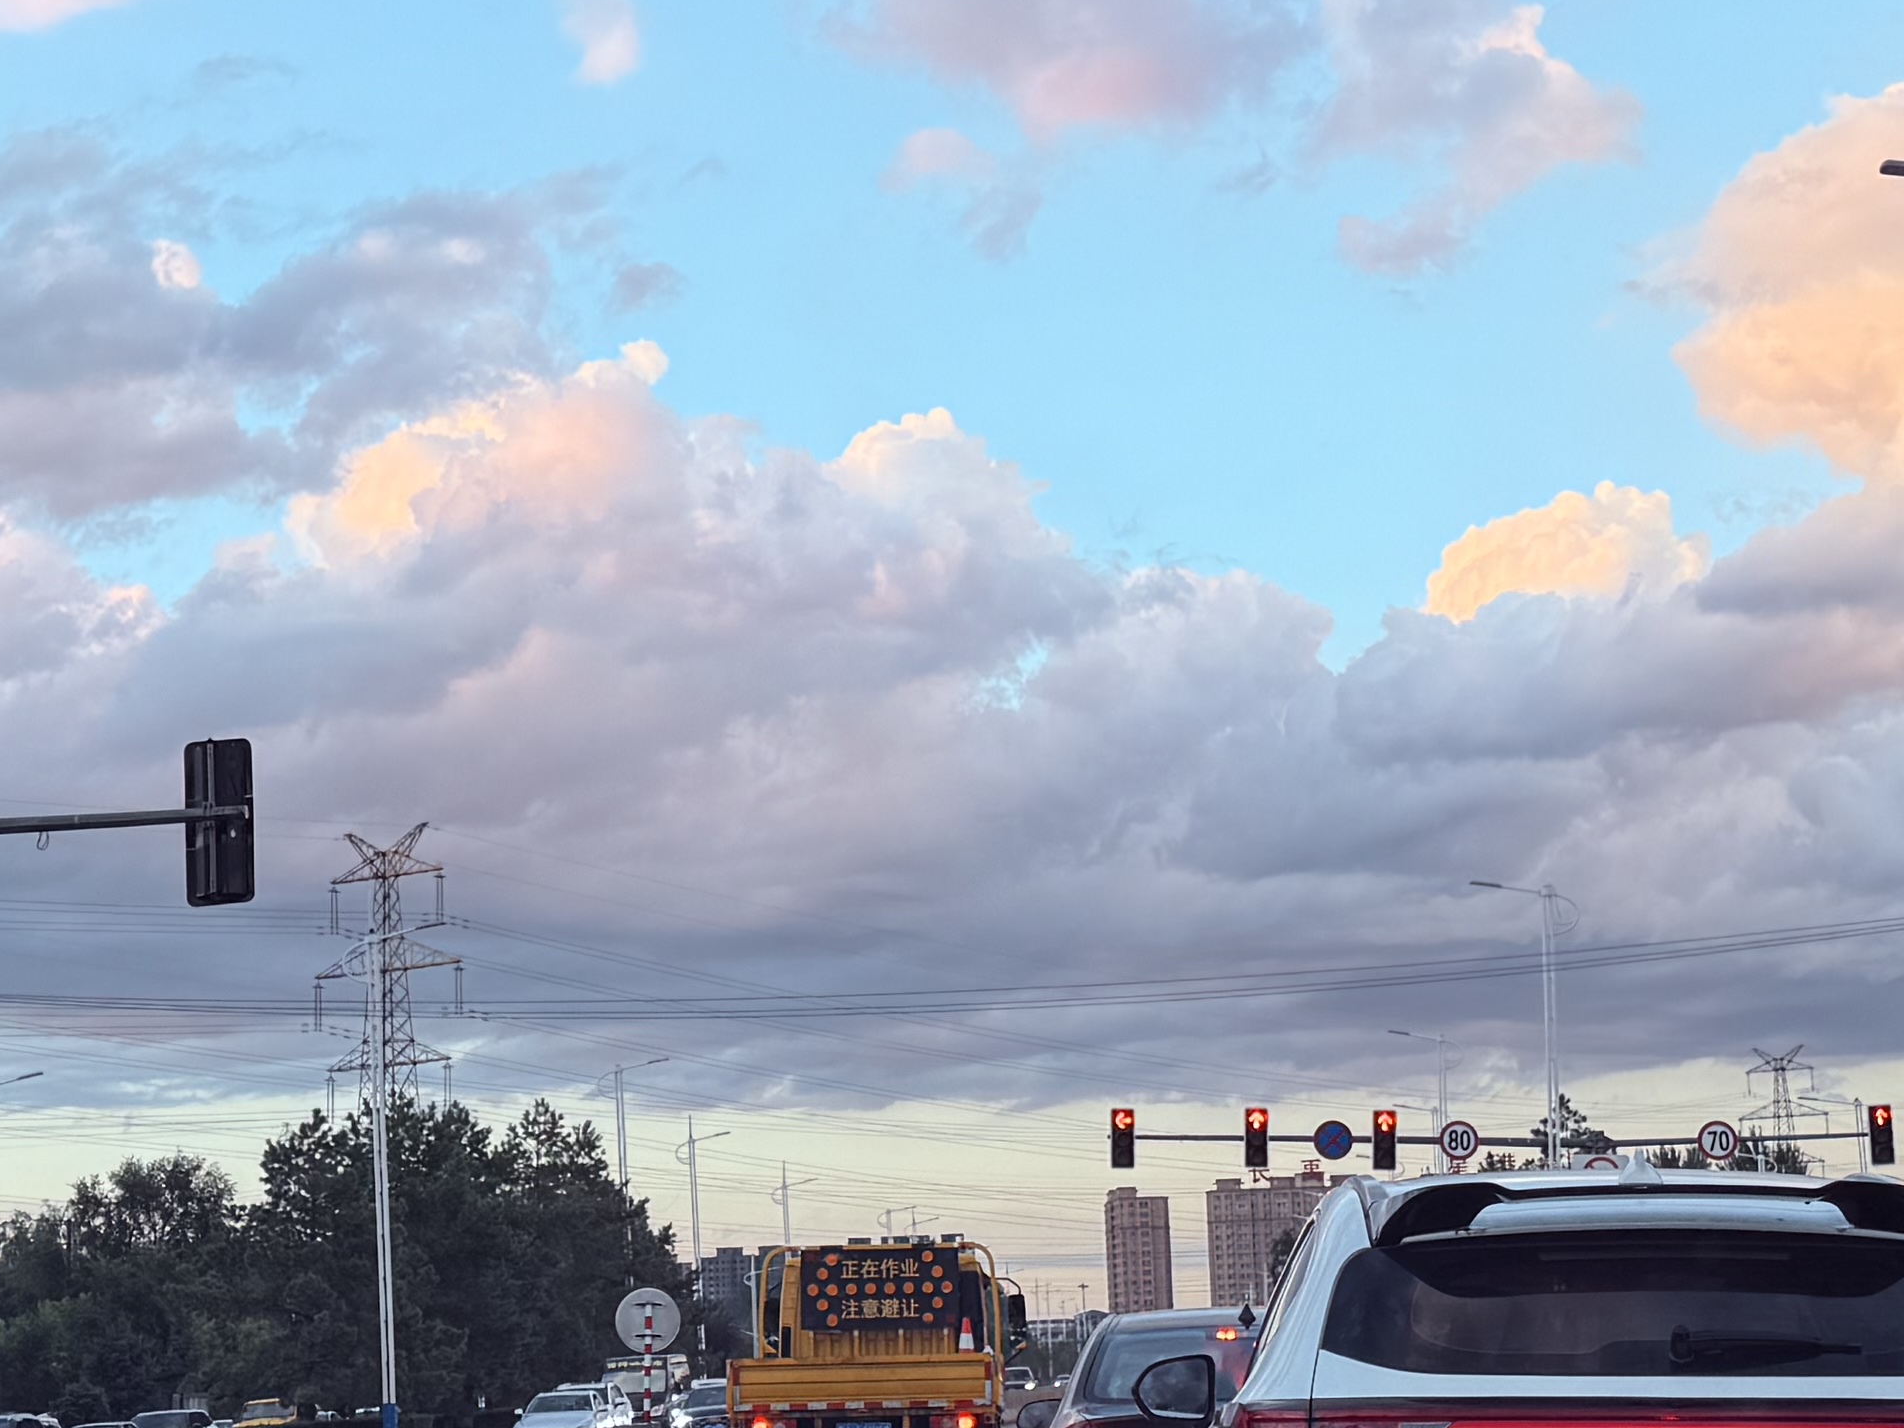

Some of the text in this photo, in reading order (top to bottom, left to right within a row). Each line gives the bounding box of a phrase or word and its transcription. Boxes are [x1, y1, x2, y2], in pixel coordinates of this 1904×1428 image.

[1448, 1130, 1471, 1151] 80
[1707, 1130, 1730, 1152] 70
[840, 1258, 920, 1279] 正在作业
[841, 1299, 920, 1319] 注意避让
